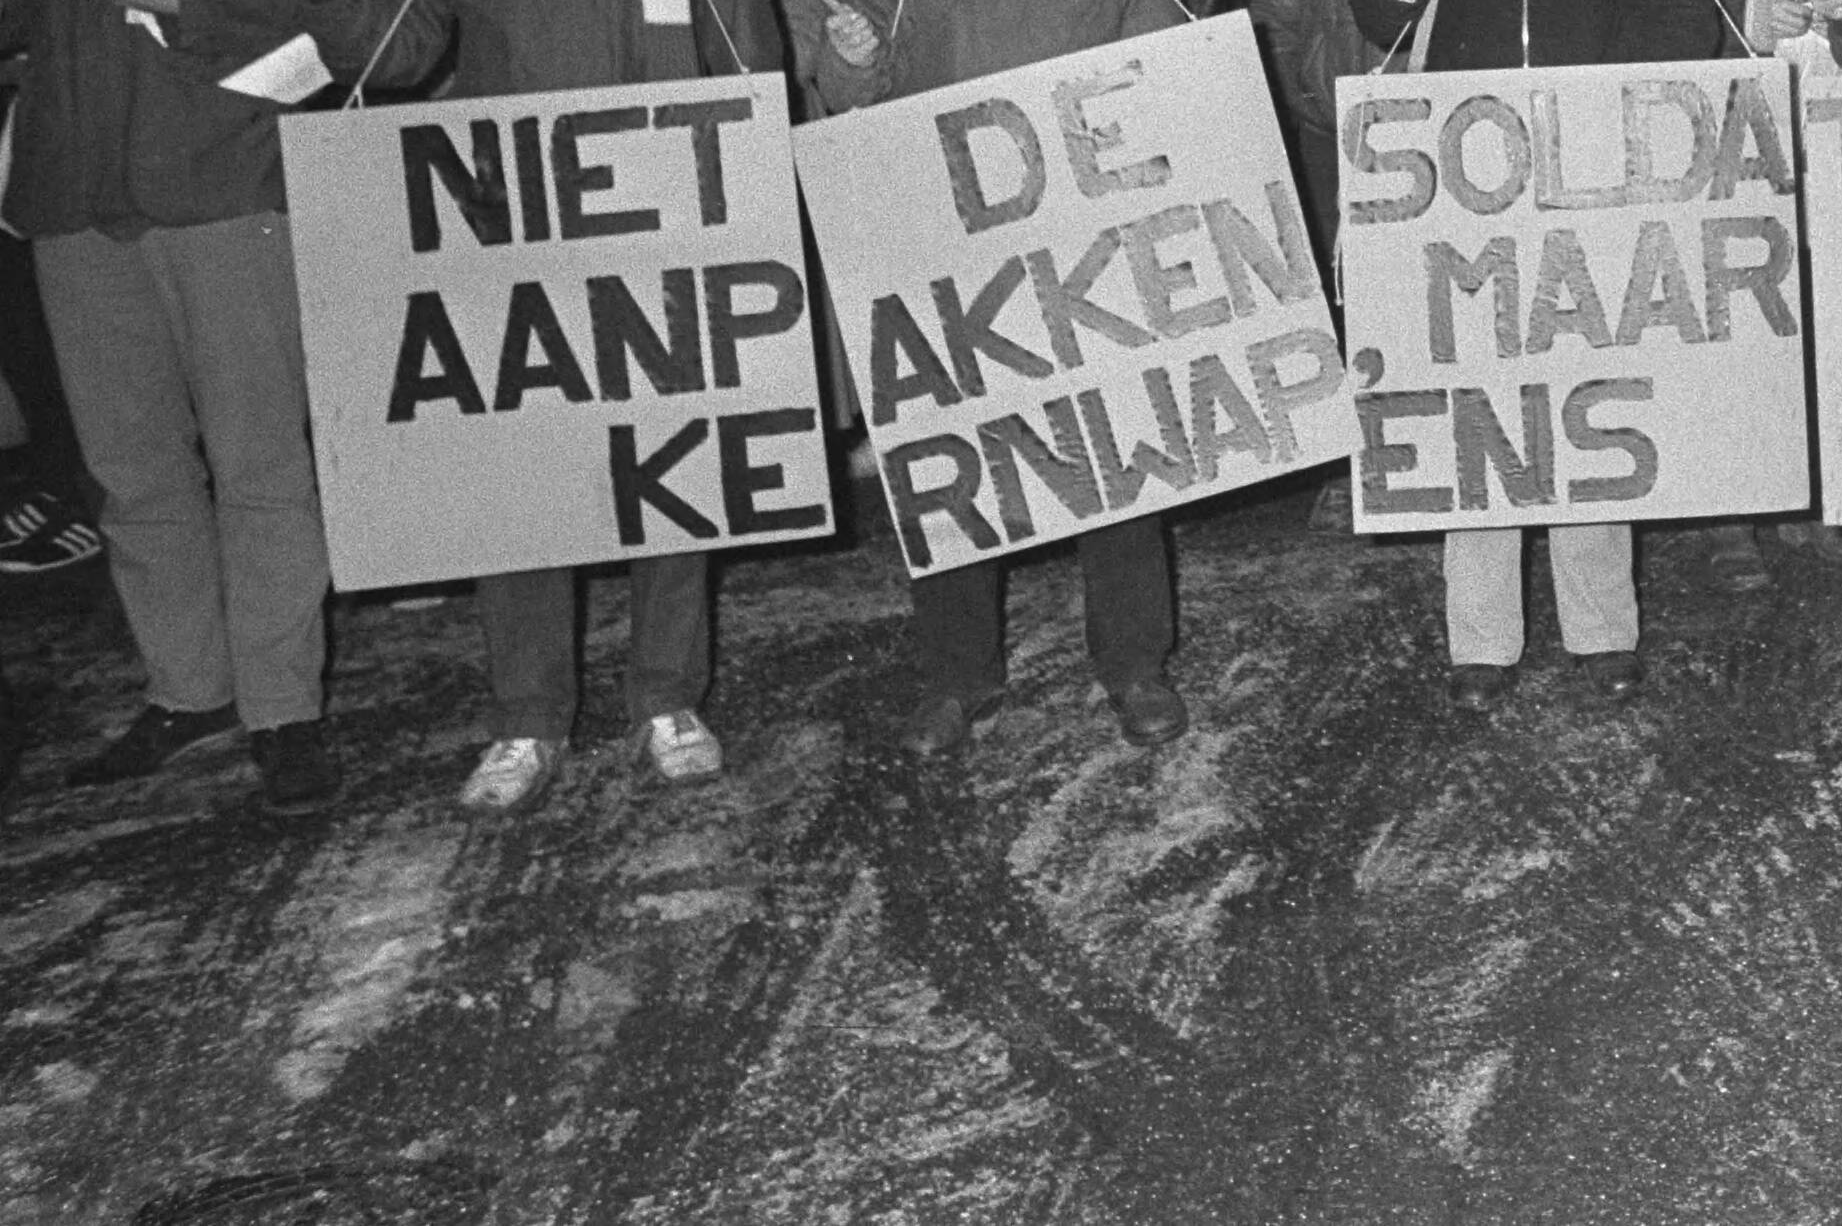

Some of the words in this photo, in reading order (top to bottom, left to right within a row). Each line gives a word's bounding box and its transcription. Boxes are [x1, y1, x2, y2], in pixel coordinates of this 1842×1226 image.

[400, 97, 752, 253] NIET
[934, 58, 1172, 234] DE
[1342, 77, 1796, 225] SOLDA
[386, 259, 804, 423] AANP
[870, 180, 1315, 427] AKKEN
[608, 407, 828, 546] KE
[884, 327, 1345, 569] RNWAP
[1354, 376, 1660, 515] ENS
